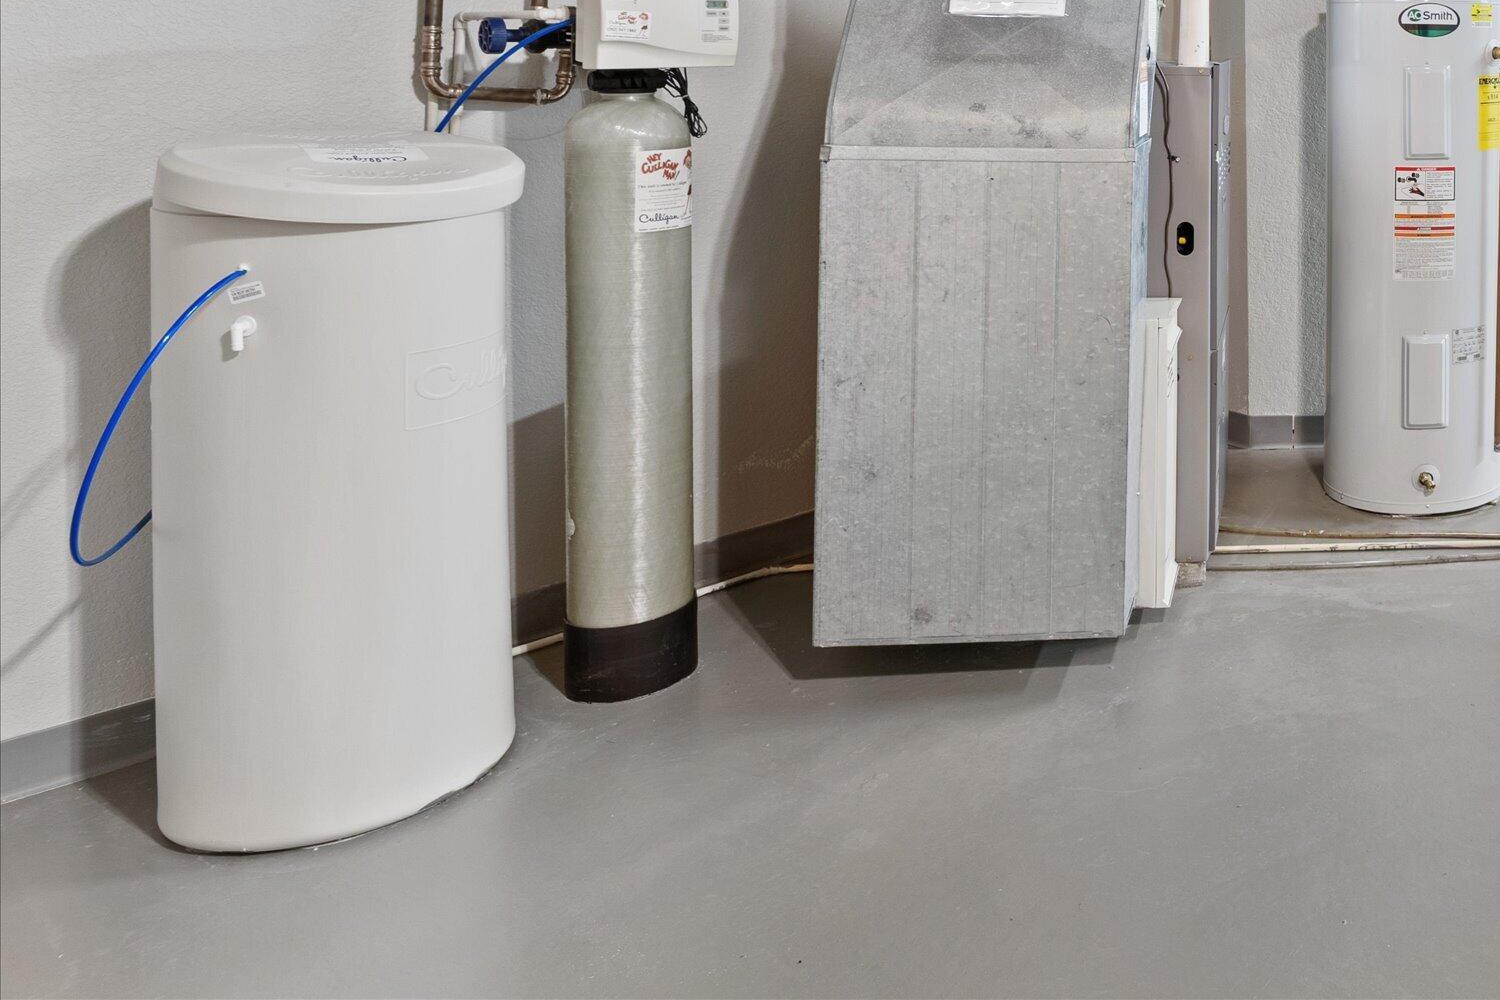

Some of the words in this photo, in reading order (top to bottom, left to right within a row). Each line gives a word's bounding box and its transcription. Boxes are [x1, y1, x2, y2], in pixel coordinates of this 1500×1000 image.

[1423, 10, 1453, 21] Smith
[329, 155, 407, 163] Culligan
[647, 152, 662, 163] HEY
[641, 159, 679, 174] CULLIGAN
[638, 212, 679, 225] Culligan
